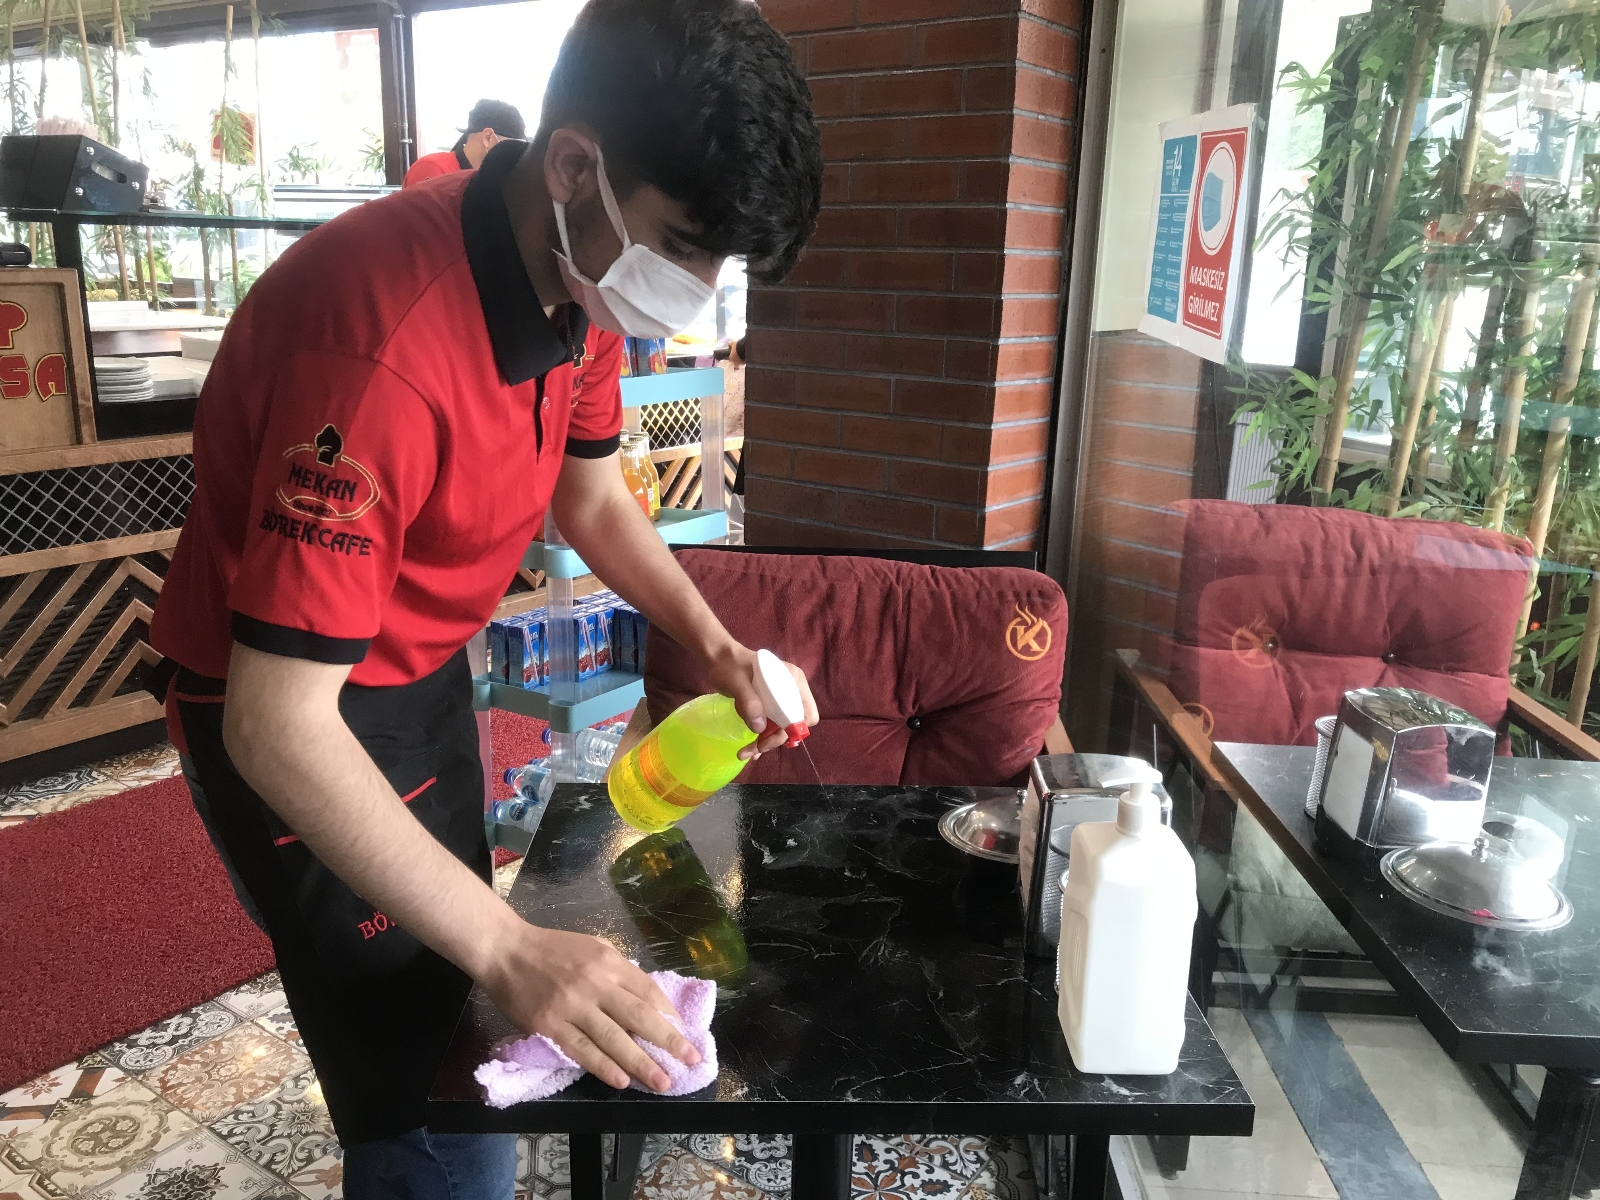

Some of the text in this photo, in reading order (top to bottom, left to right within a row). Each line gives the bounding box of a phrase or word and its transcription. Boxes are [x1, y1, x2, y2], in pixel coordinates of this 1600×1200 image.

[1190, 266, 1226, 291] MASKESİZ
[1188, 292, 1220, 322] GİRİLMEZ
[287, 462, 358, 502] MEKAN
[357, 911, 396, 940] BÖ
